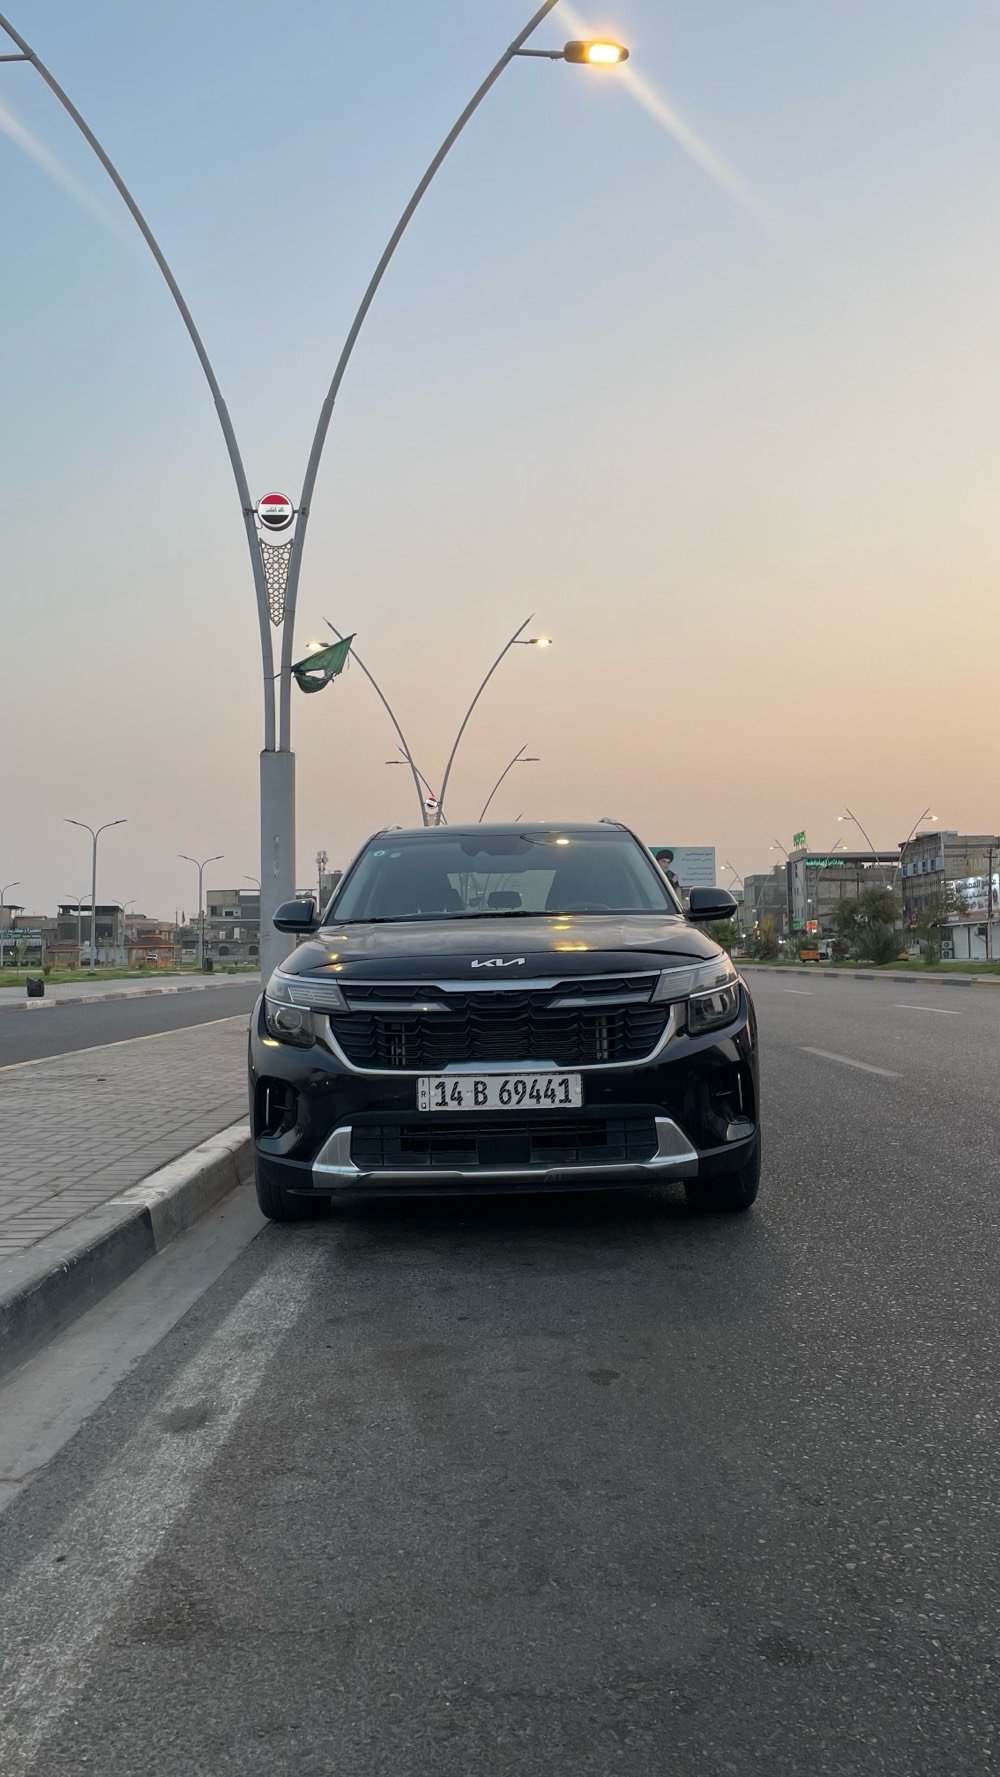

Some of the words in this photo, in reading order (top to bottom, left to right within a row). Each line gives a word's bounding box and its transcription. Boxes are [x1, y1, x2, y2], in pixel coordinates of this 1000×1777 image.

[434, 1081, 464, 1107] 14
[473, 1080, 488, 1106] B
[498, 1078, 572, 1105] 69441
